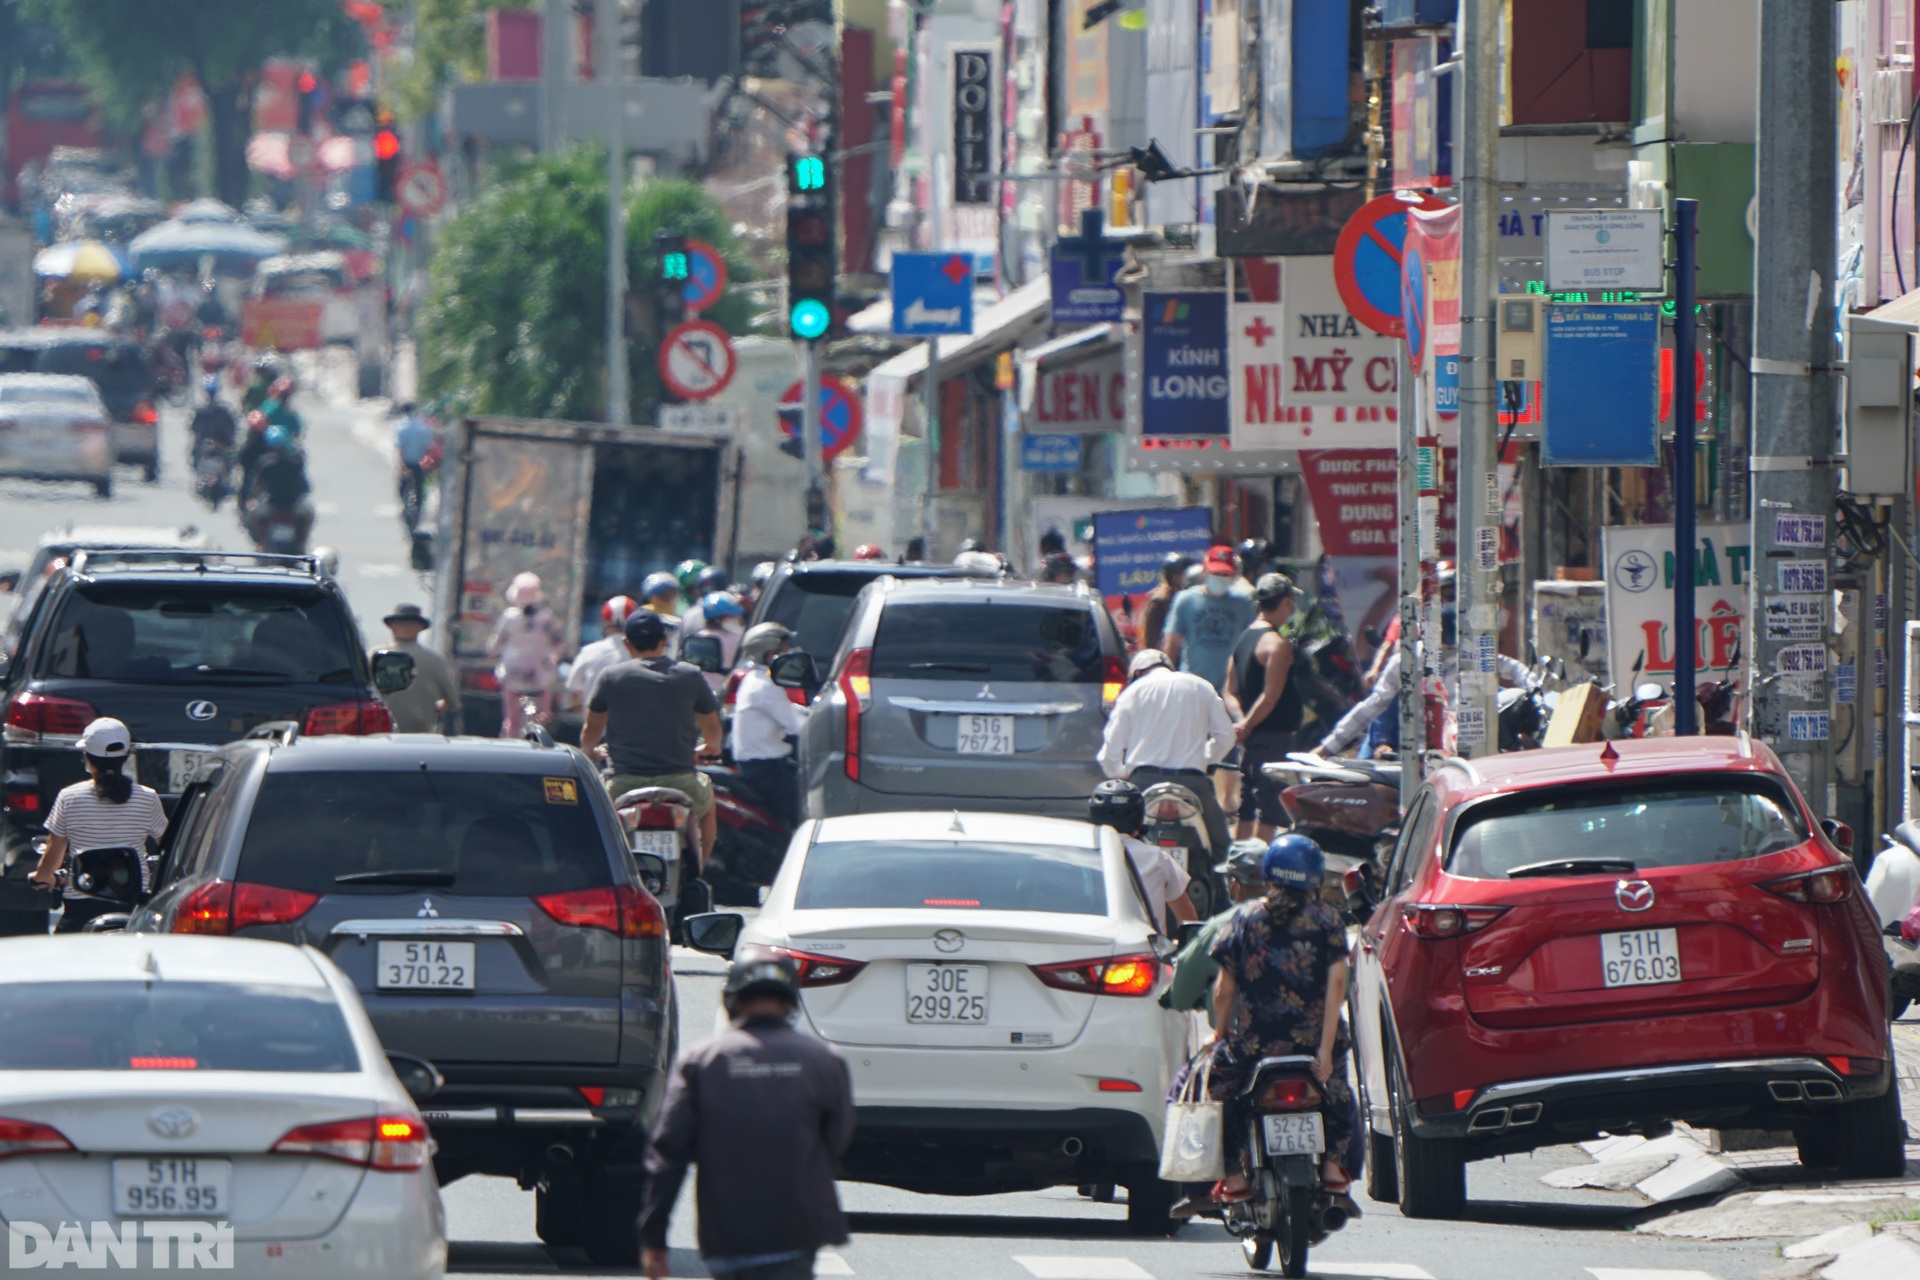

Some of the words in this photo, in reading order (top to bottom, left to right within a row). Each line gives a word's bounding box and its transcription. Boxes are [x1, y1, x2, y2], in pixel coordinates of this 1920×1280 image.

[960, 54, 987, 201] DOLLY
[1584, 268, 1601, 276] BUS
[1603, 267, 1625, 276] STOP
[1168, 342, 1219, 365] KÍNH
[1292, 347, 1353, 392] MỸ
[1151, 376, 1229, 399] LONG
[972, 717, 1001, 733] 51G
[406, 944, 446, 963] 51A
[1619, 931, 1660, 957] 51H
[389, 966, 464, 986] 370.22
[927, 969, 968, 993] 30E
[1466, 965, 1503, 977] CX-5
[1607, 957, 1679, 984] 676.03
[910, 996, 985, 1020] 299.25
[1276, 1134, 1316, 1151] 7645
[149, 1160, 197, 1184] 51H
[128, 1185, 217, 1211] 956.95
